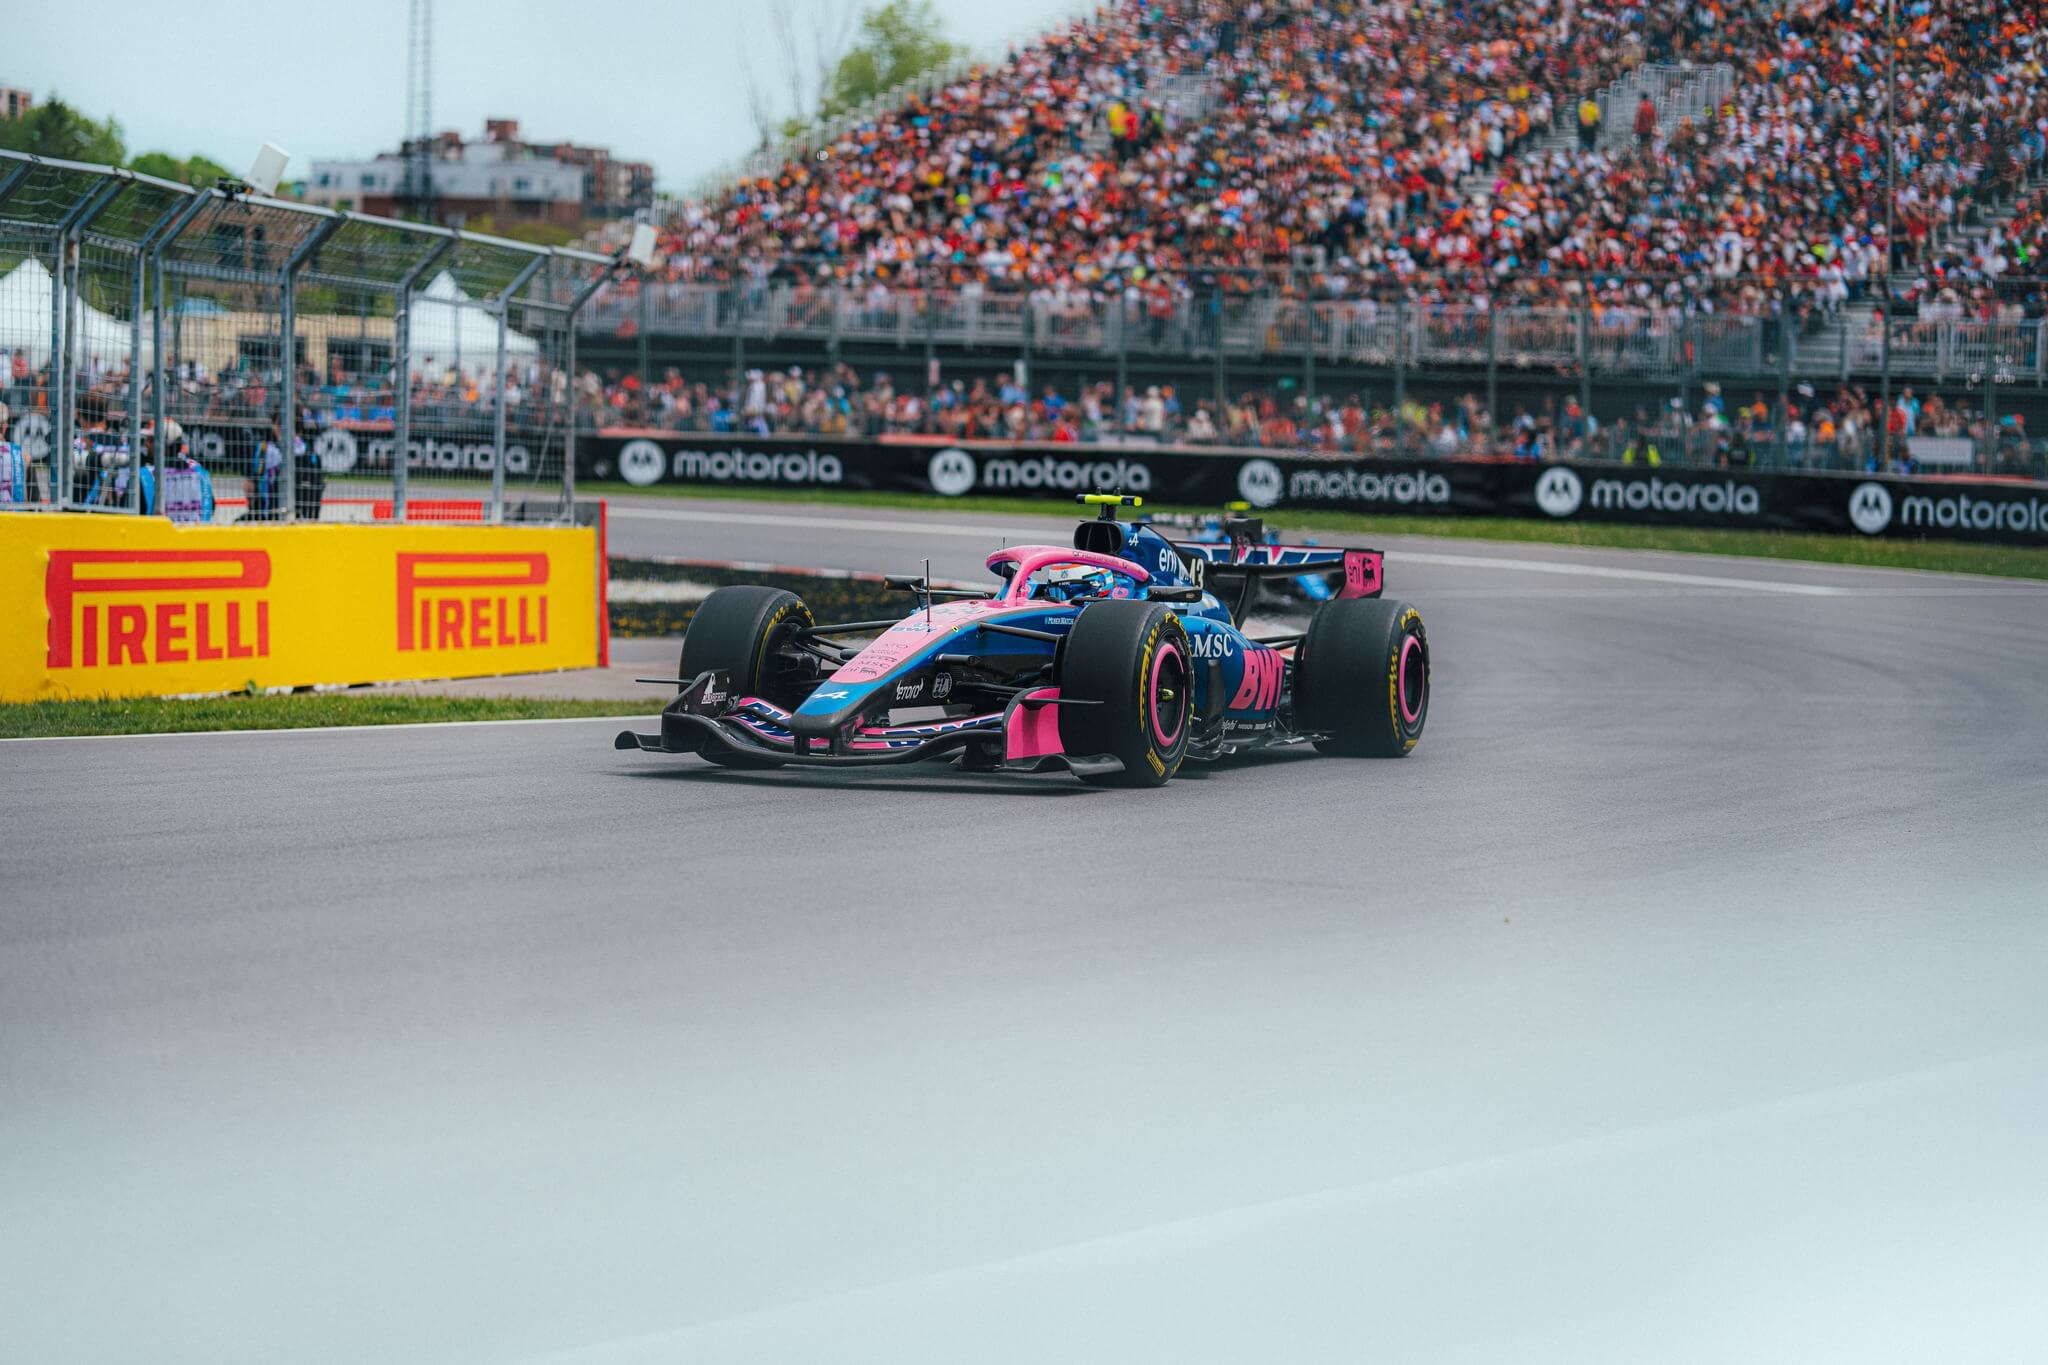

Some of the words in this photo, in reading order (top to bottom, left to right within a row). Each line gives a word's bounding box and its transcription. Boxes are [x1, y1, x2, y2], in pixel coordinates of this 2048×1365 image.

[368, 438, 529, 473] motoroa
[673, 448, 843, 482] motorola
[983, 456, 1150, 491] motorola
[1290, 467, 1449, 503] motorola
[1591, 476, 1760, 515] motorola
[45, 549, 271, 668] PIRELLI
[396, 552, 549, 651] PIRELLI
[1192, 633, 1234, 658] MSC
[1228, 648, 1284, 710] BWT
